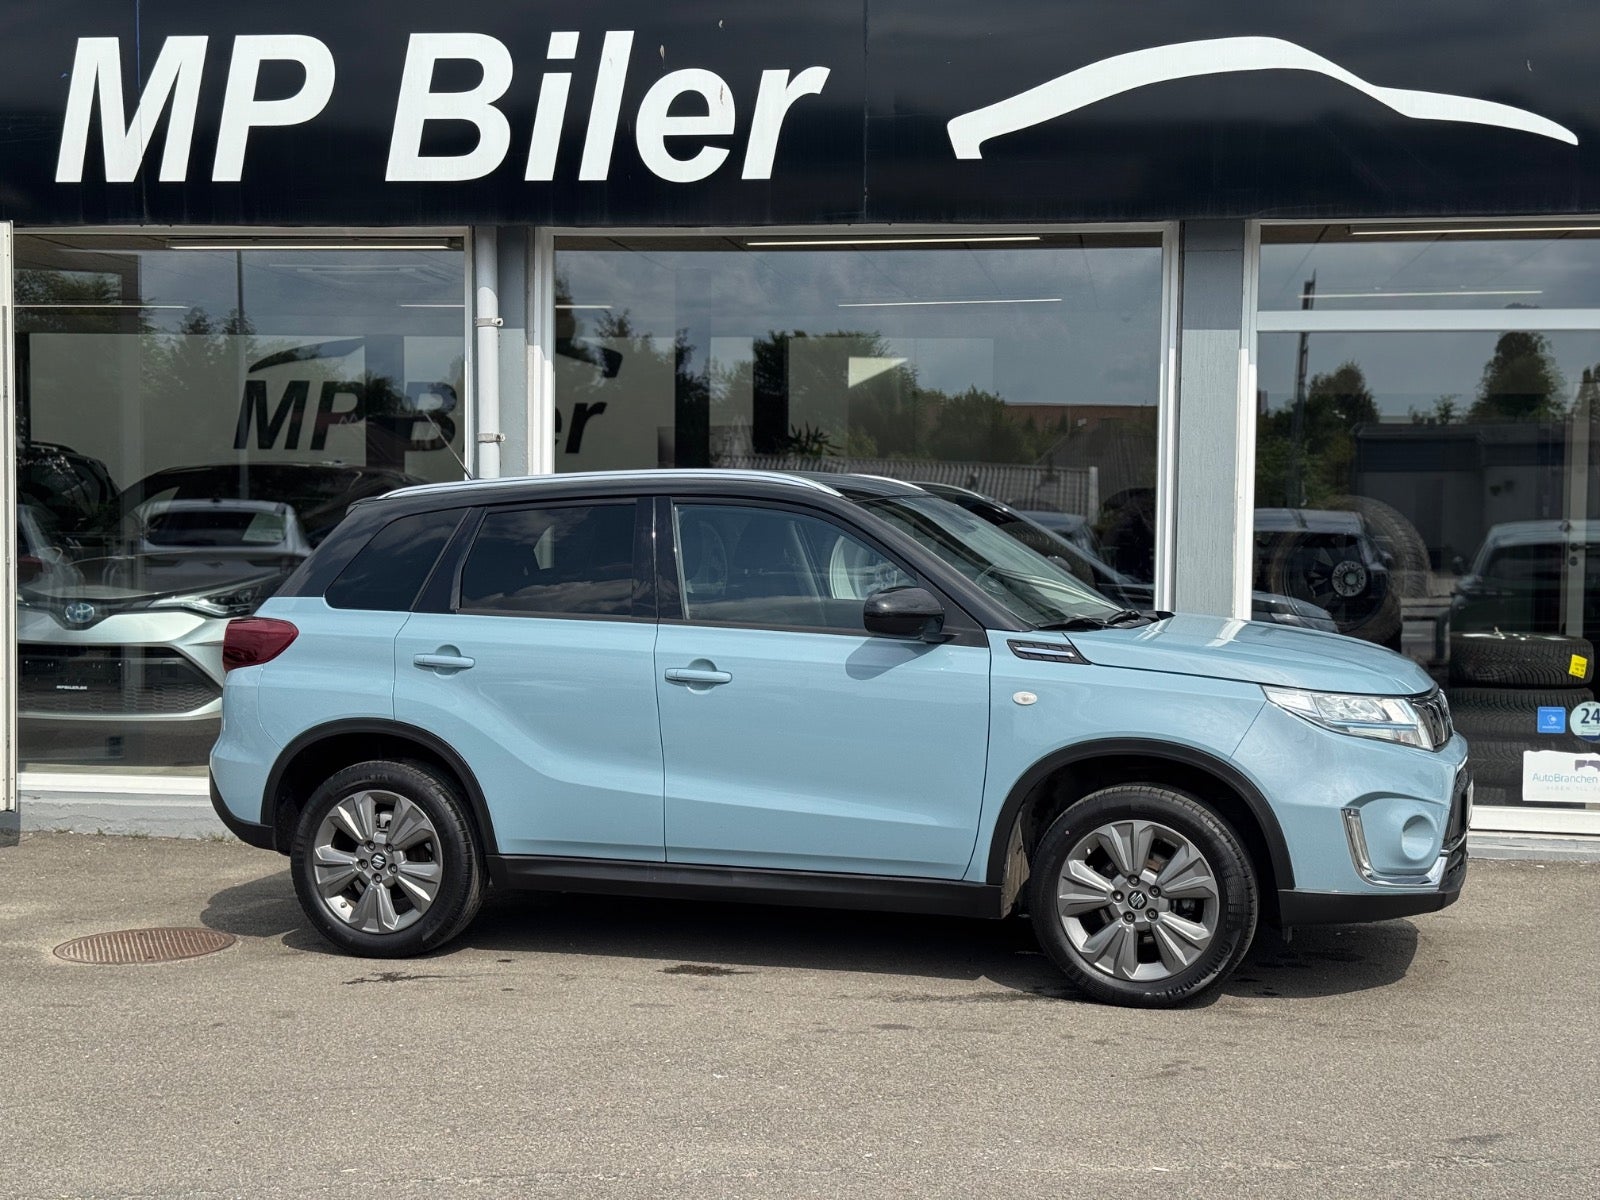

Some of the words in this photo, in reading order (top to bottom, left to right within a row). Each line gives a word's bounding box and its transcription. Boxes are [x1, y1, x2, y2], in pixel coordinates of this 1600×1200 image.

[55, 34, 336, 183] MP
[385, 30, 831, 183] Biler
[233, 380, 366, 451] MP
[1580, 707, 1600, 724] 24
[1532, 773, 1598, 784] AutoBranchen
